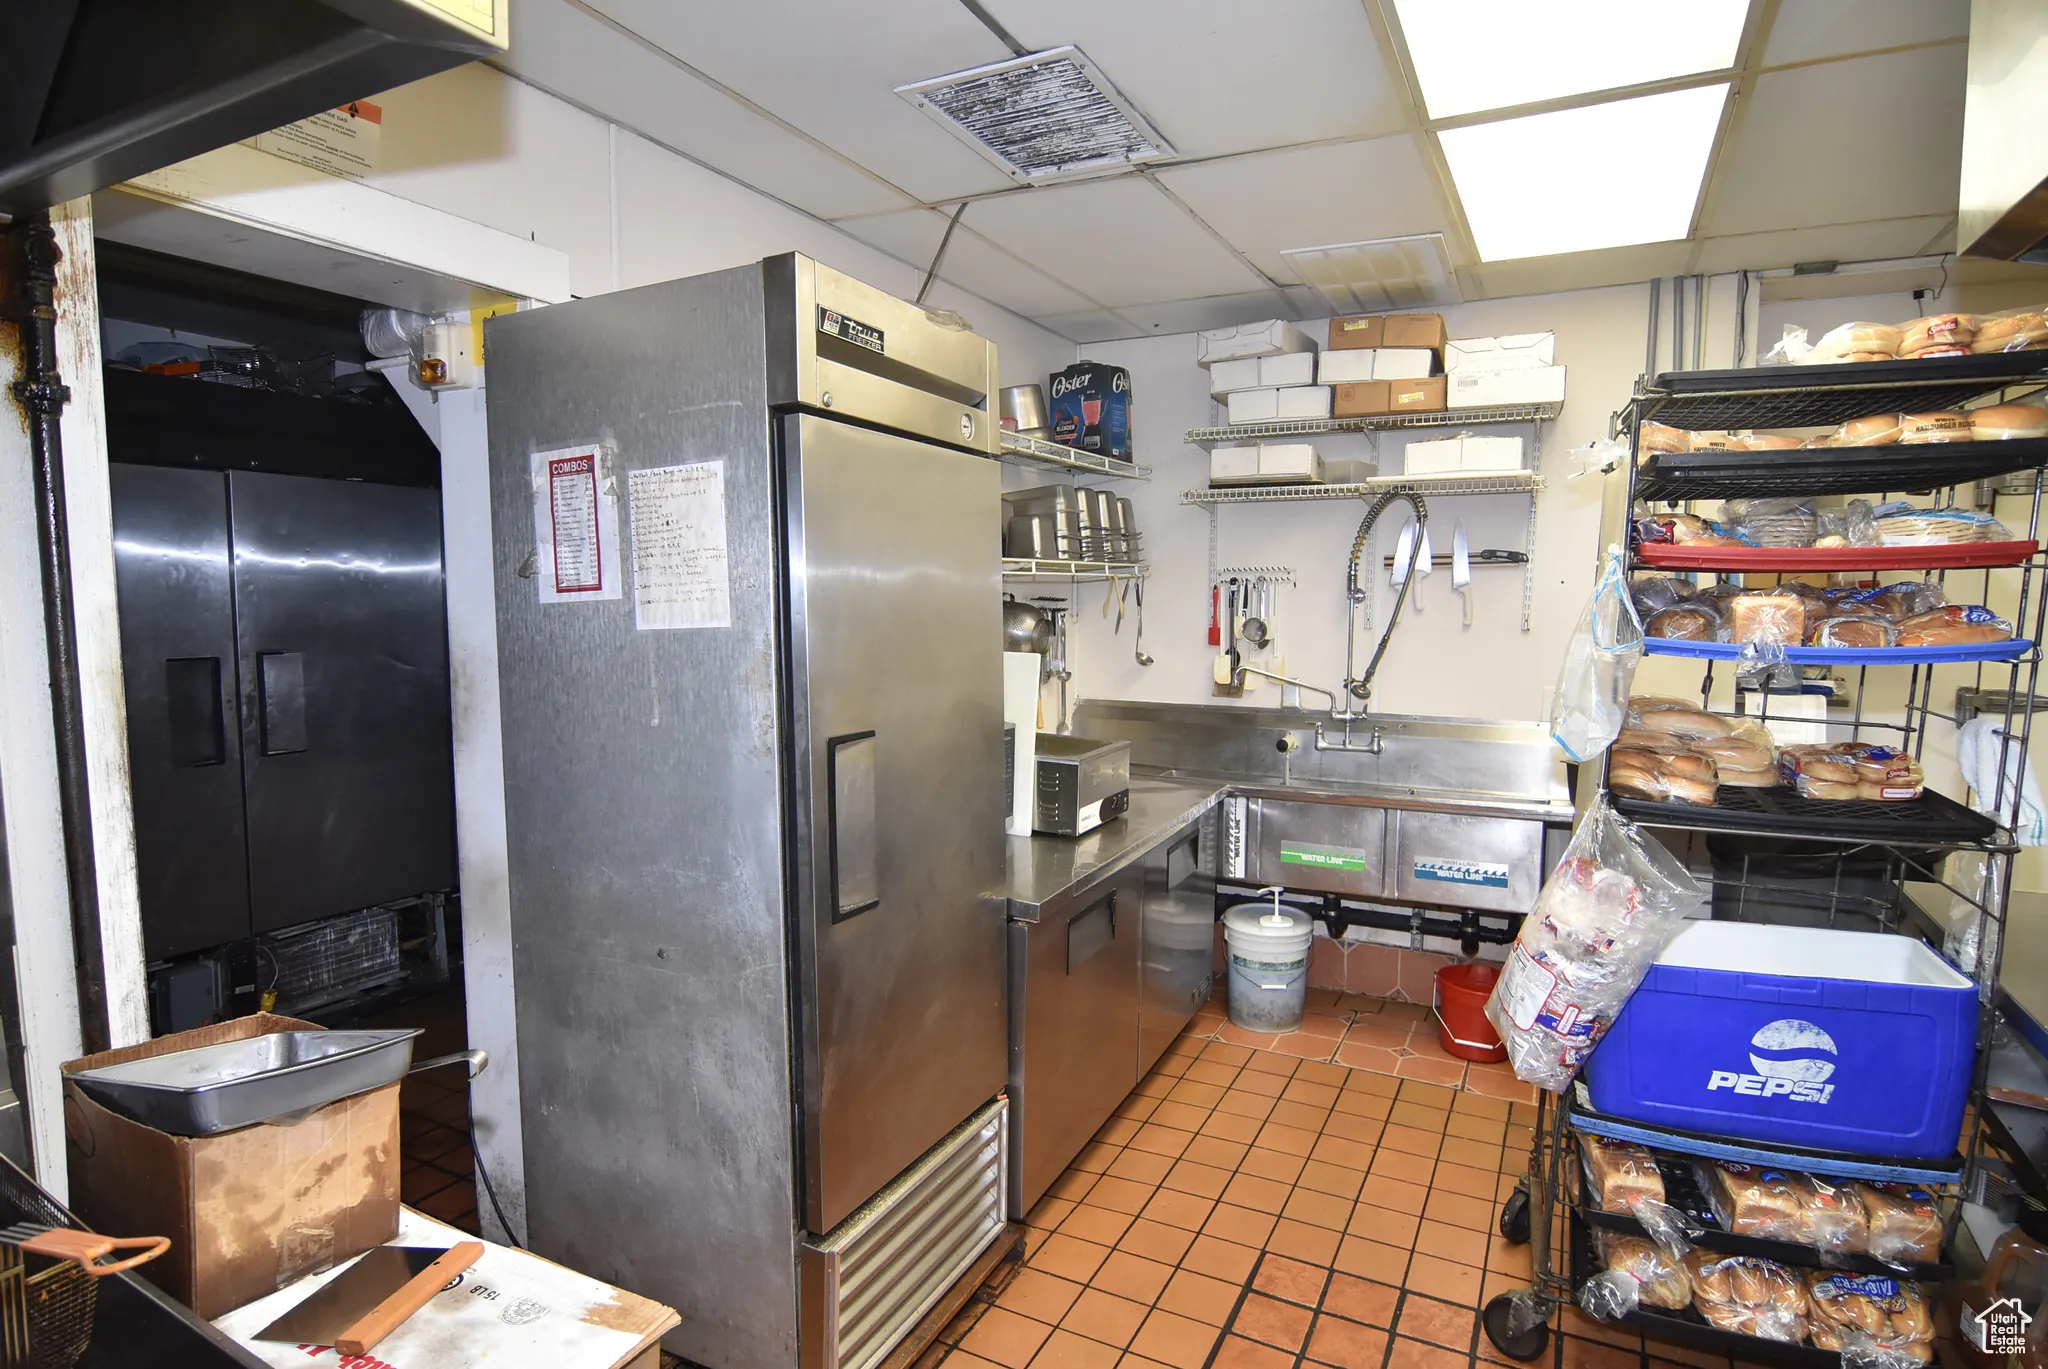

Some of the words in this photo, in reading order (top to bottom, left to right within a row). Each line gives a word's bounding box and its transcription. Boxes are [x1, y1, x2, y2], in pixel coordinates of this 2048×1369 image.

[848, 333, 882, 350] FREEZER
[1052, 373, 1092, 398] Oster
[1056, 424, 1075, 432] BLENDER
[1916, 422, 1956, 432] HAMBURGER
[1958, 420, 1976, 428] BUNS
[552, 460, 588, 474] COMBOS
[1301, 854, 1325, 863] WATER
[1326, 856, 1343, 865] LINE
[1437, 870, 1464, 879] WATER
[1465, 872, 1483, 881] LINE
[1707, 1070, 1836, 1104] PEPSI
[469, 1284, 487, 1297] LB
[484, 1290, 500, 1301] 15
